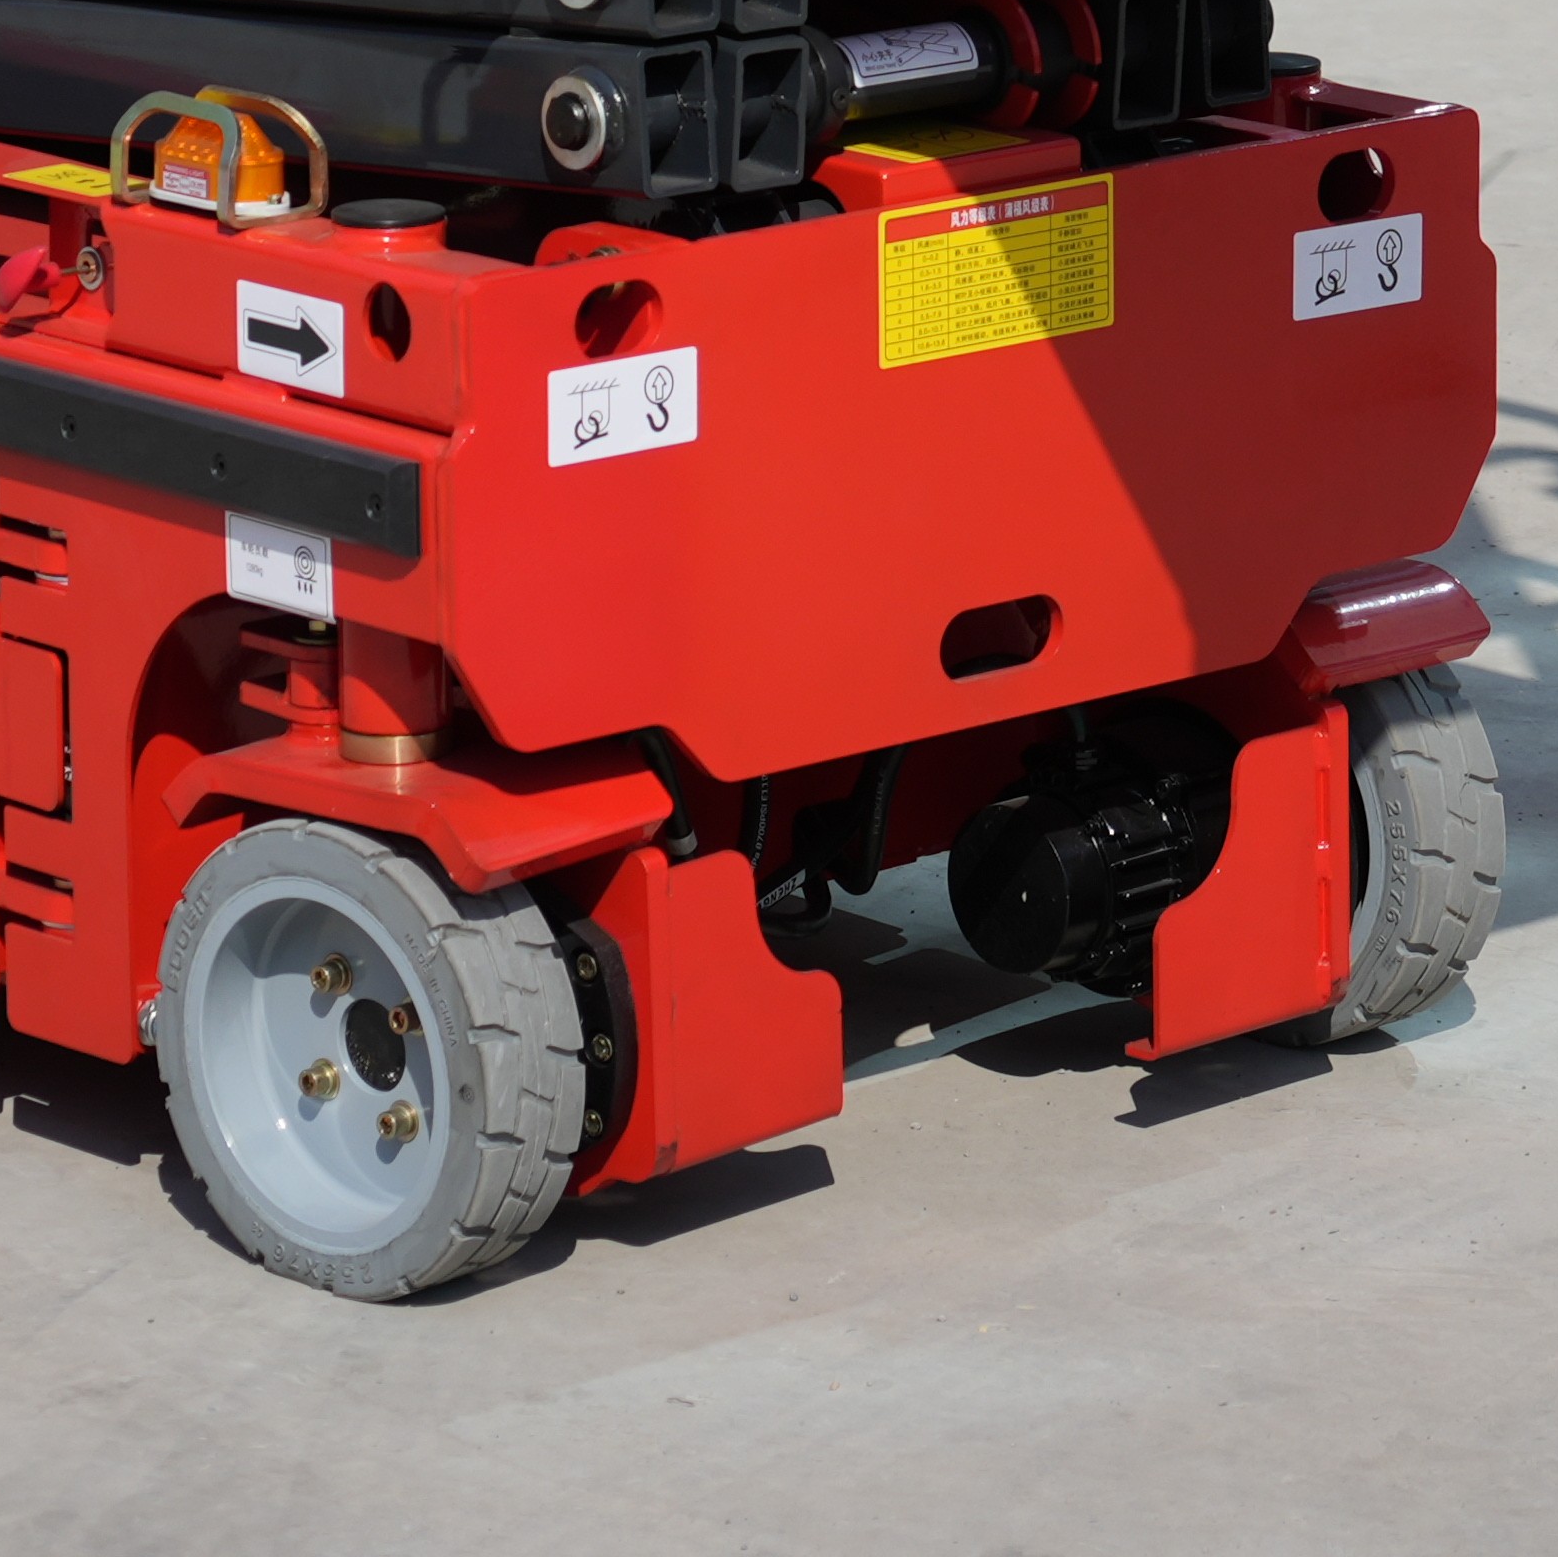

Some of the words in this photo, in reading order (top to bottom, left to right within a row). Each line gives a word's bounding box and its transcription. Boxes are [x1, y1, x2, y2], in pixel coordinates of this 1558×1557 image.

[1385, 799, 1408, 925] 255X76
[437, 1001, 459, 1050] CHINA
[273, 1244, 375, 1286] 255X76
